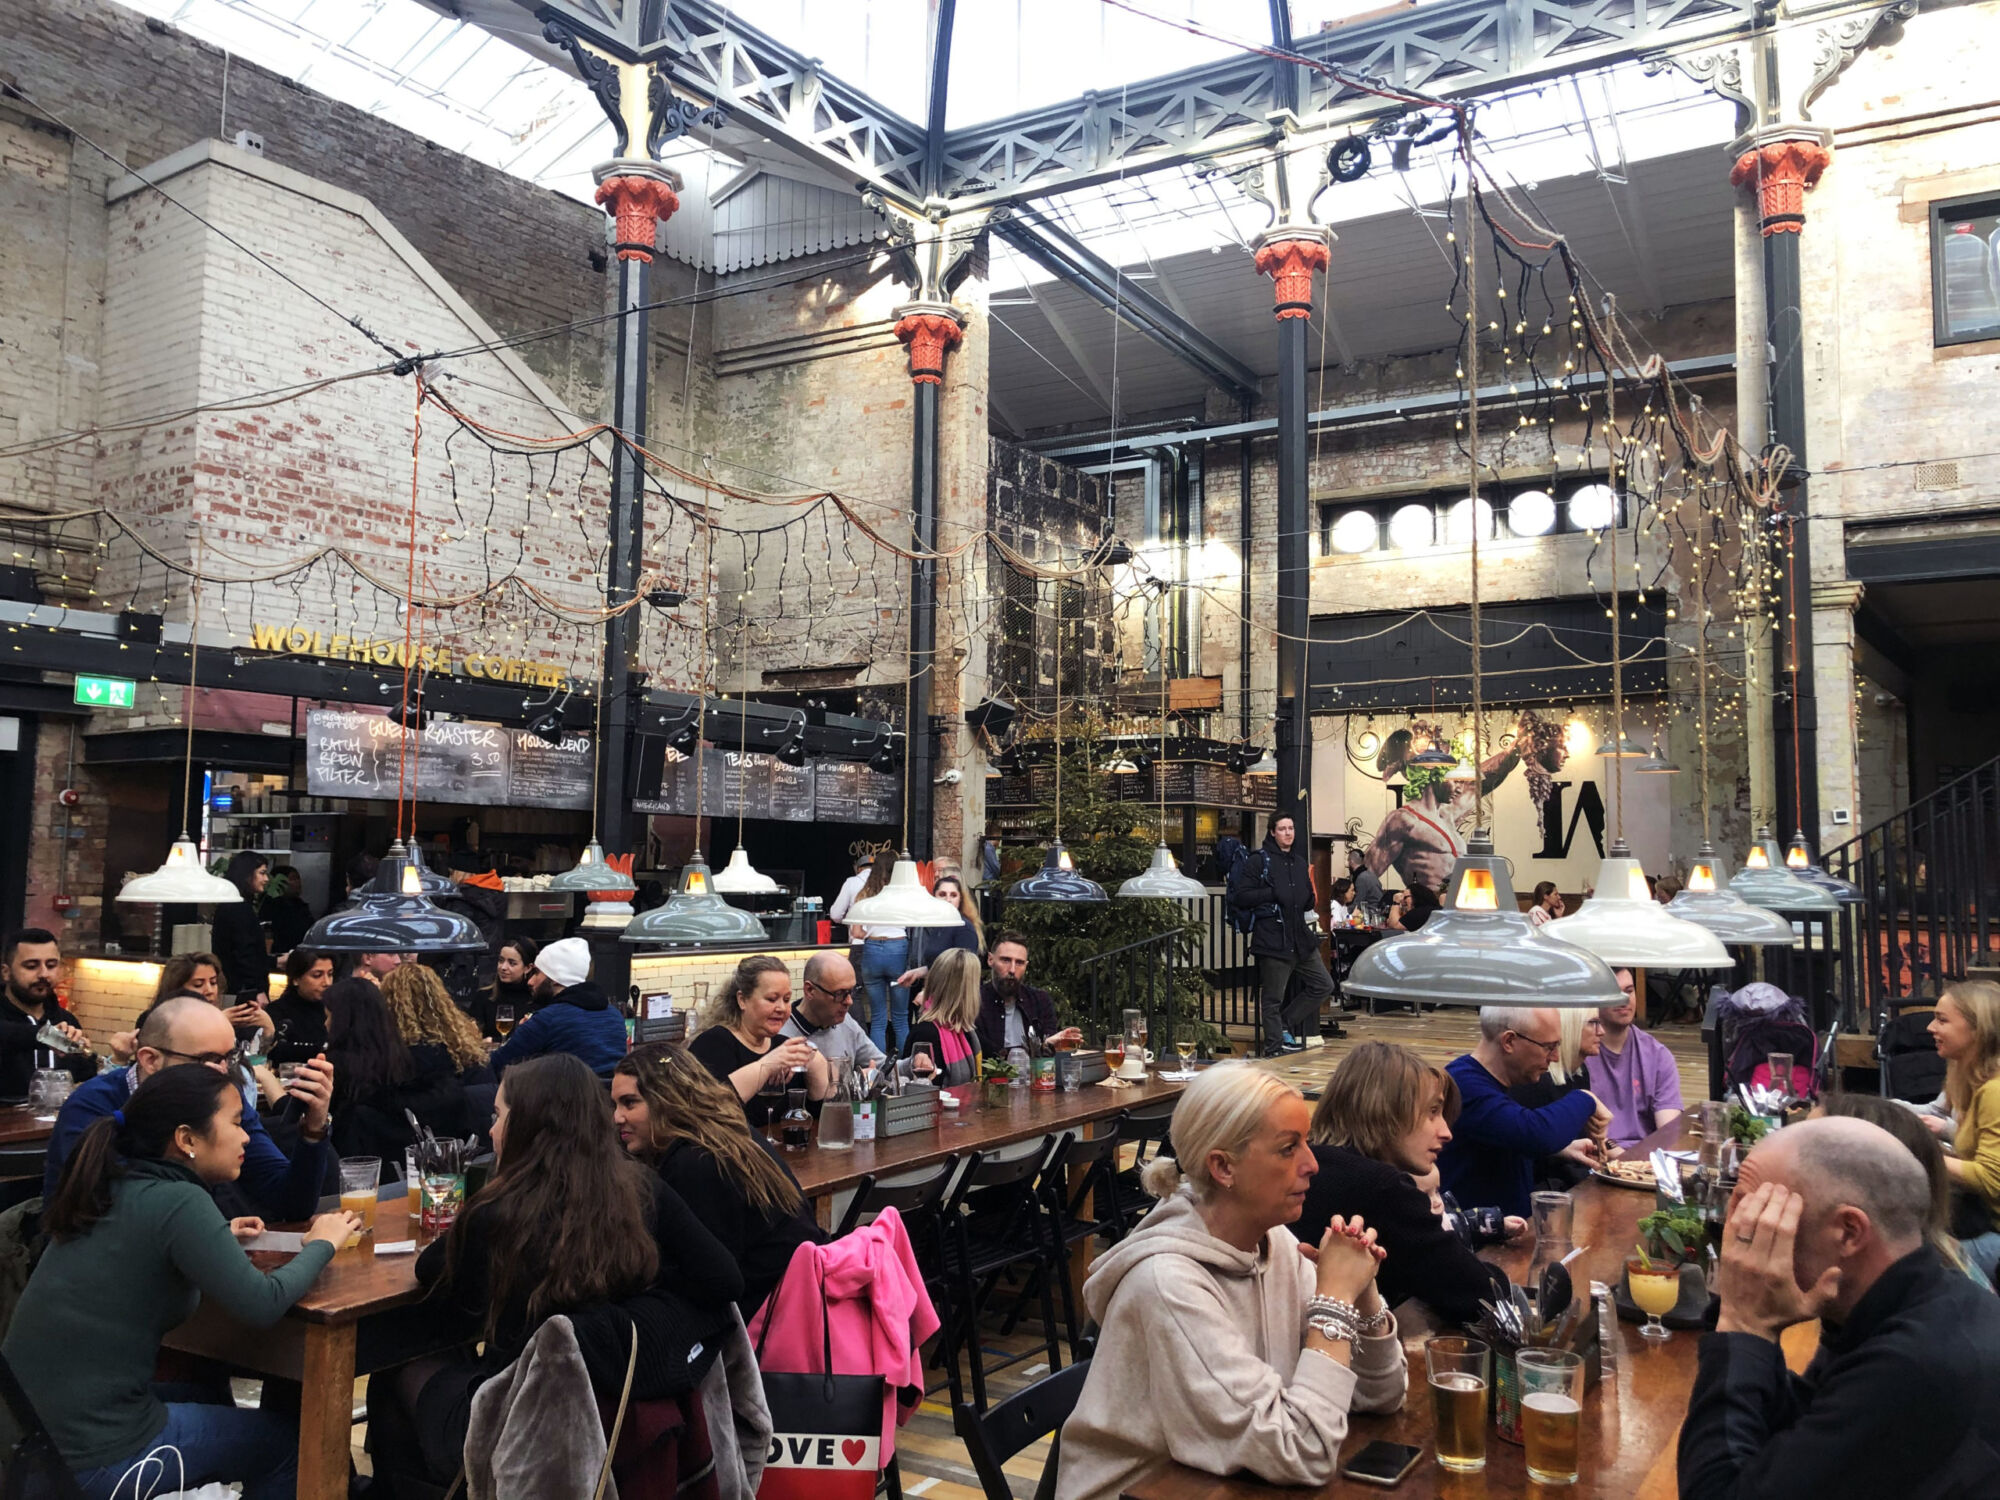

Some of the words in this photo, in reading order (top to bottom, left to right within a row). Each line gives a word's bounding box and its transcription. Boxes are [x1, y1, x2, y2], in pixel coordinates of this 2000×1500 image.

[250, 623, 451, 673] WOLFHOUSE
[465, 653, 566, 689] COFFEE
[424, 723, 499, 747] ROASTER
[320, 737, 361, 753] BATCH
[320, 752, 363, 768] BREW
[725, 752, 753, 768] TEAS
[315, 767, 369, 784] FILTER
[766, 1437, 835, 1466] OVE
